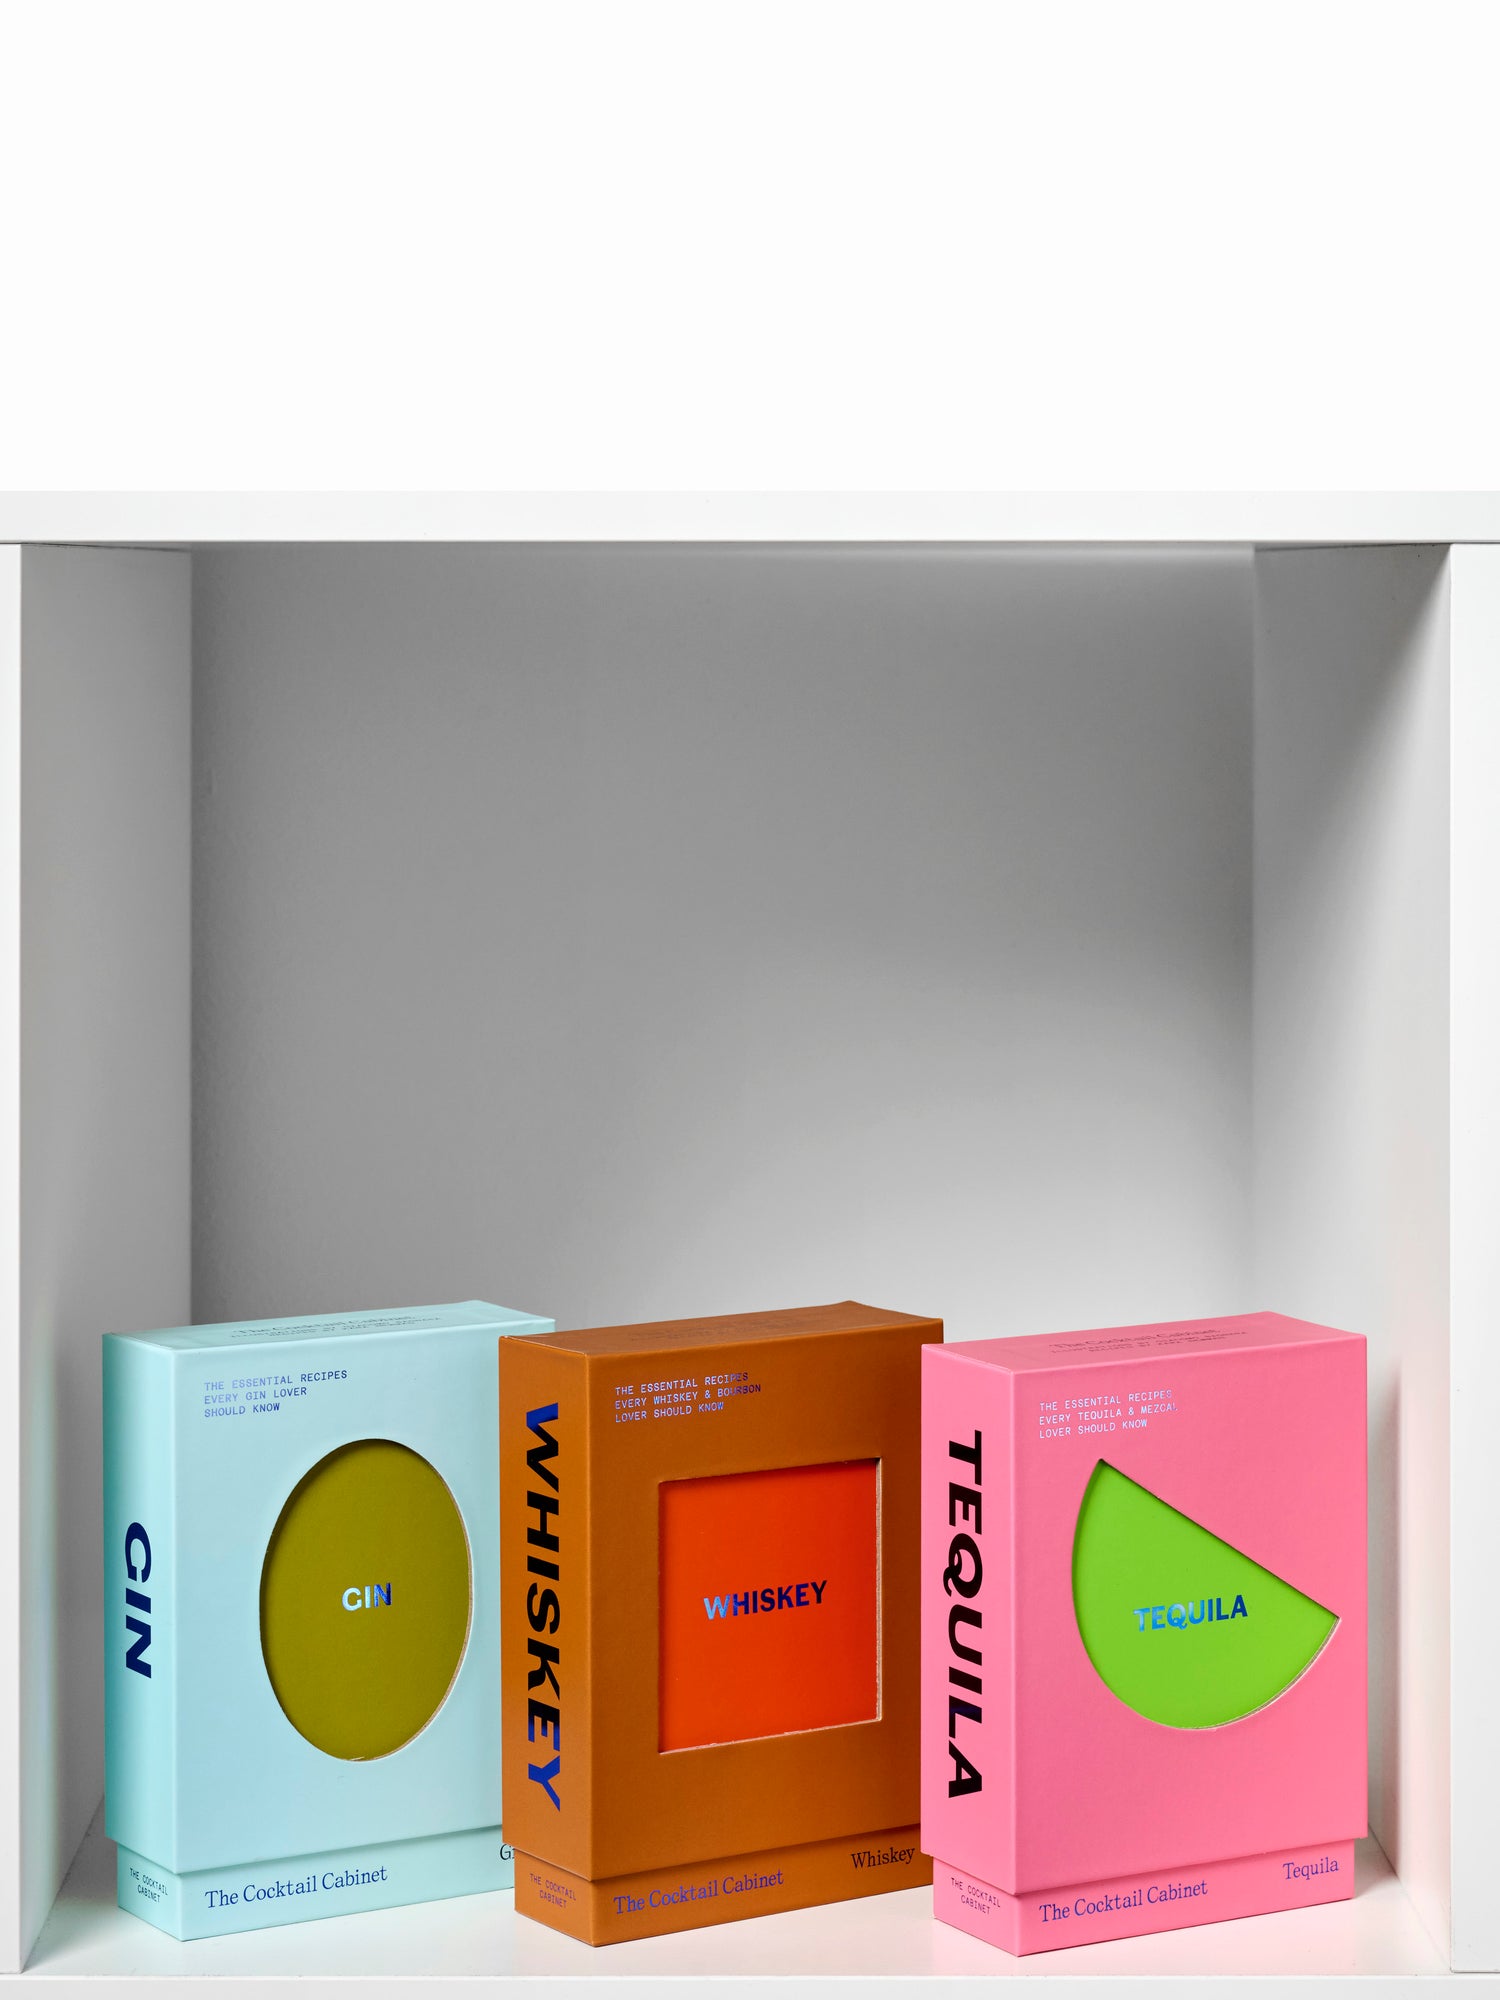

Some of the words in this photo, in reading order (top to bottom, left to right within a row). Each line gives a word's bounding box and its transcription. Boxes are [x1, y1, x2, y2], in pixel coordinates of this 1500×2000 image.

[204, 1381, 224, 1391] THE
[232, 1376, 293, 1389] ESSENTIAL
[300, 1370, 347, 1382] RECIPES
[615, 1385, 634, 1396] THE
[641, 1378, 698, 1394] ESSENTIAL
[705, 1372, 749, 1386] RECIPES
[204, 1393, 238, 1405] EVERY
[245, 1390, 266, 1401] GIN
[273, 1387, 307, 1398] LOVER
[615, 1398, 647, 1409] EVERY
[653, 1392, 698, 1405] WHISKEY
[705, 1390, 711, 1399] &
[717, 1384, 761, 1398] BOURBON
[1040, 1402, 1058, 1411] THE
[1065, 1395, 1121, 1409] ESSENTIAL
[1128, 1389, 1172, 1402] RECIPES
[204, 1405, 246, 1418] SHOULD
[253, 1402, 280, 1413] KNOW
[615, 1410, 647, 1422] LOVER
[653, 1405, 692, 1419] SHOULD
[698, 1401, 724, 1412] KNOW
[1039, 1414, 1071, 1425] EVERY
[1078, 1408, 1122, 1421] TEQUILA
[1128, 1407, 1134, 1416] &
[1141, 1402, 1178, 1414] MEZCAL
[1039, 1426, 1071, 1439] LOVER
[1078, 1422, 1116, 1435] SHOULD
[1122, 1418, 1148, 1429] KNOW
[125, 1522, 152, 1679] GIN
[342, 1582, 392, 1612] GIN
[526, 1402, 561, 1812] WHISKEY
[703, 1580, 827, 1620] WHISKEY
[942, 1429, 983, 1799] TEQUILA
[1133, 1594, 1248, 1632] TEQUILA
[851, 1847, 916, 1869] Whiskey
[1283, 1856, 1339, 1880] Tequila
[129, 1867, 140, 1880] THE
[142, 1875, 168, 1895] COCKTAIL
[137, 1884, 161, 1902] CABINET
[205, 1889, 239, 1908] The
[243, 1875, 317, 1902] Cocktail
[322, 1866, 388, 1890] Cabinet
[530, 1873, 541, 1885] THE
[545, 1880, 576, 1901] COCKTAIL
[613, 1895, 645, 1914] The
[649, 1879, 718, 1908] Cocktail
[722, 1869, 784, 1894] Cabinet
[951, 1877, 963, 1890] THE
[967, 1885, 1000, 1908] COCKTAIL
[539, 1890, 567, 1908] CABINET
[961, 1895, 990, 1914] CABINET
[1039, 1903, 1070, 1922] The
[1074, 1889, 1143, 1916] Cocktail
[1147, 1880, 1208, 1904] Cabinet
